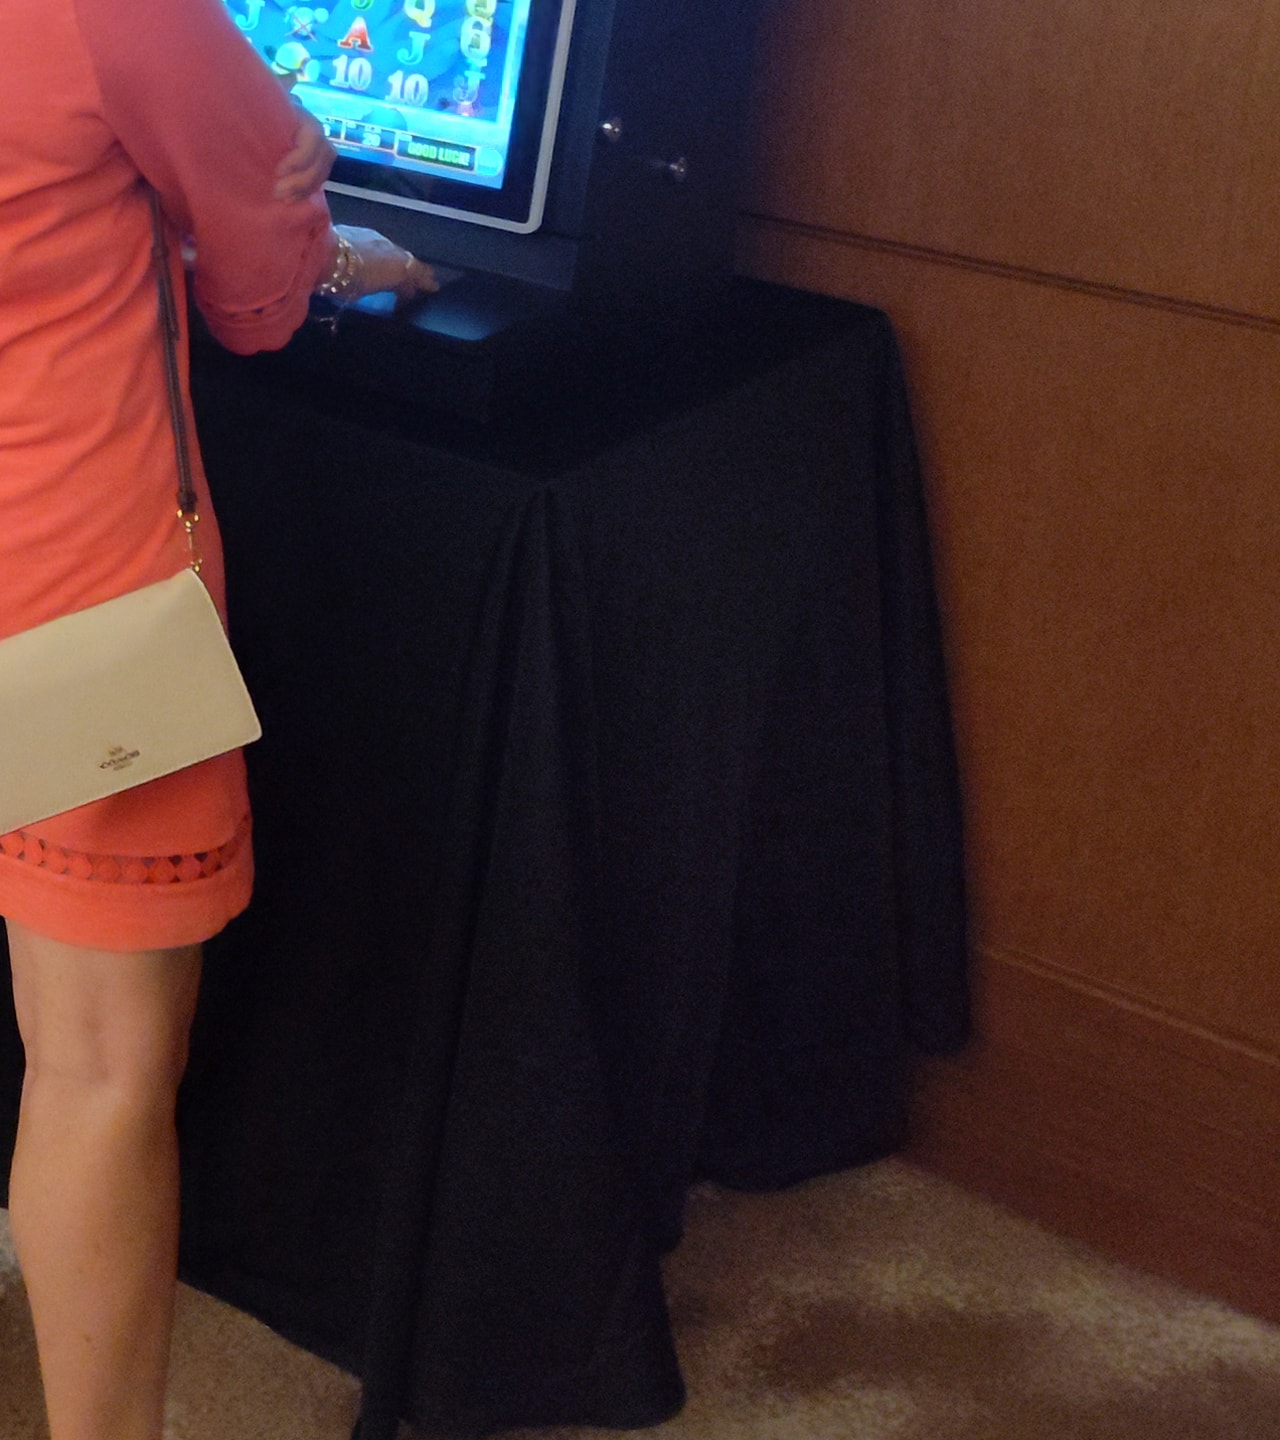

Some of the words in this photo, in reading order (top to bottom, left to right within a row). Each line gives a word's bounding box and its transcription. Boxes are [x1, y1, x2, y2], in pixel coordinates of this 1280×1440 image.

[338, 16, 373, 52] A
[397, 31, 431, 64] J
[330, 54, 372, 91] 10
[385, 70, 429, 106] 10
